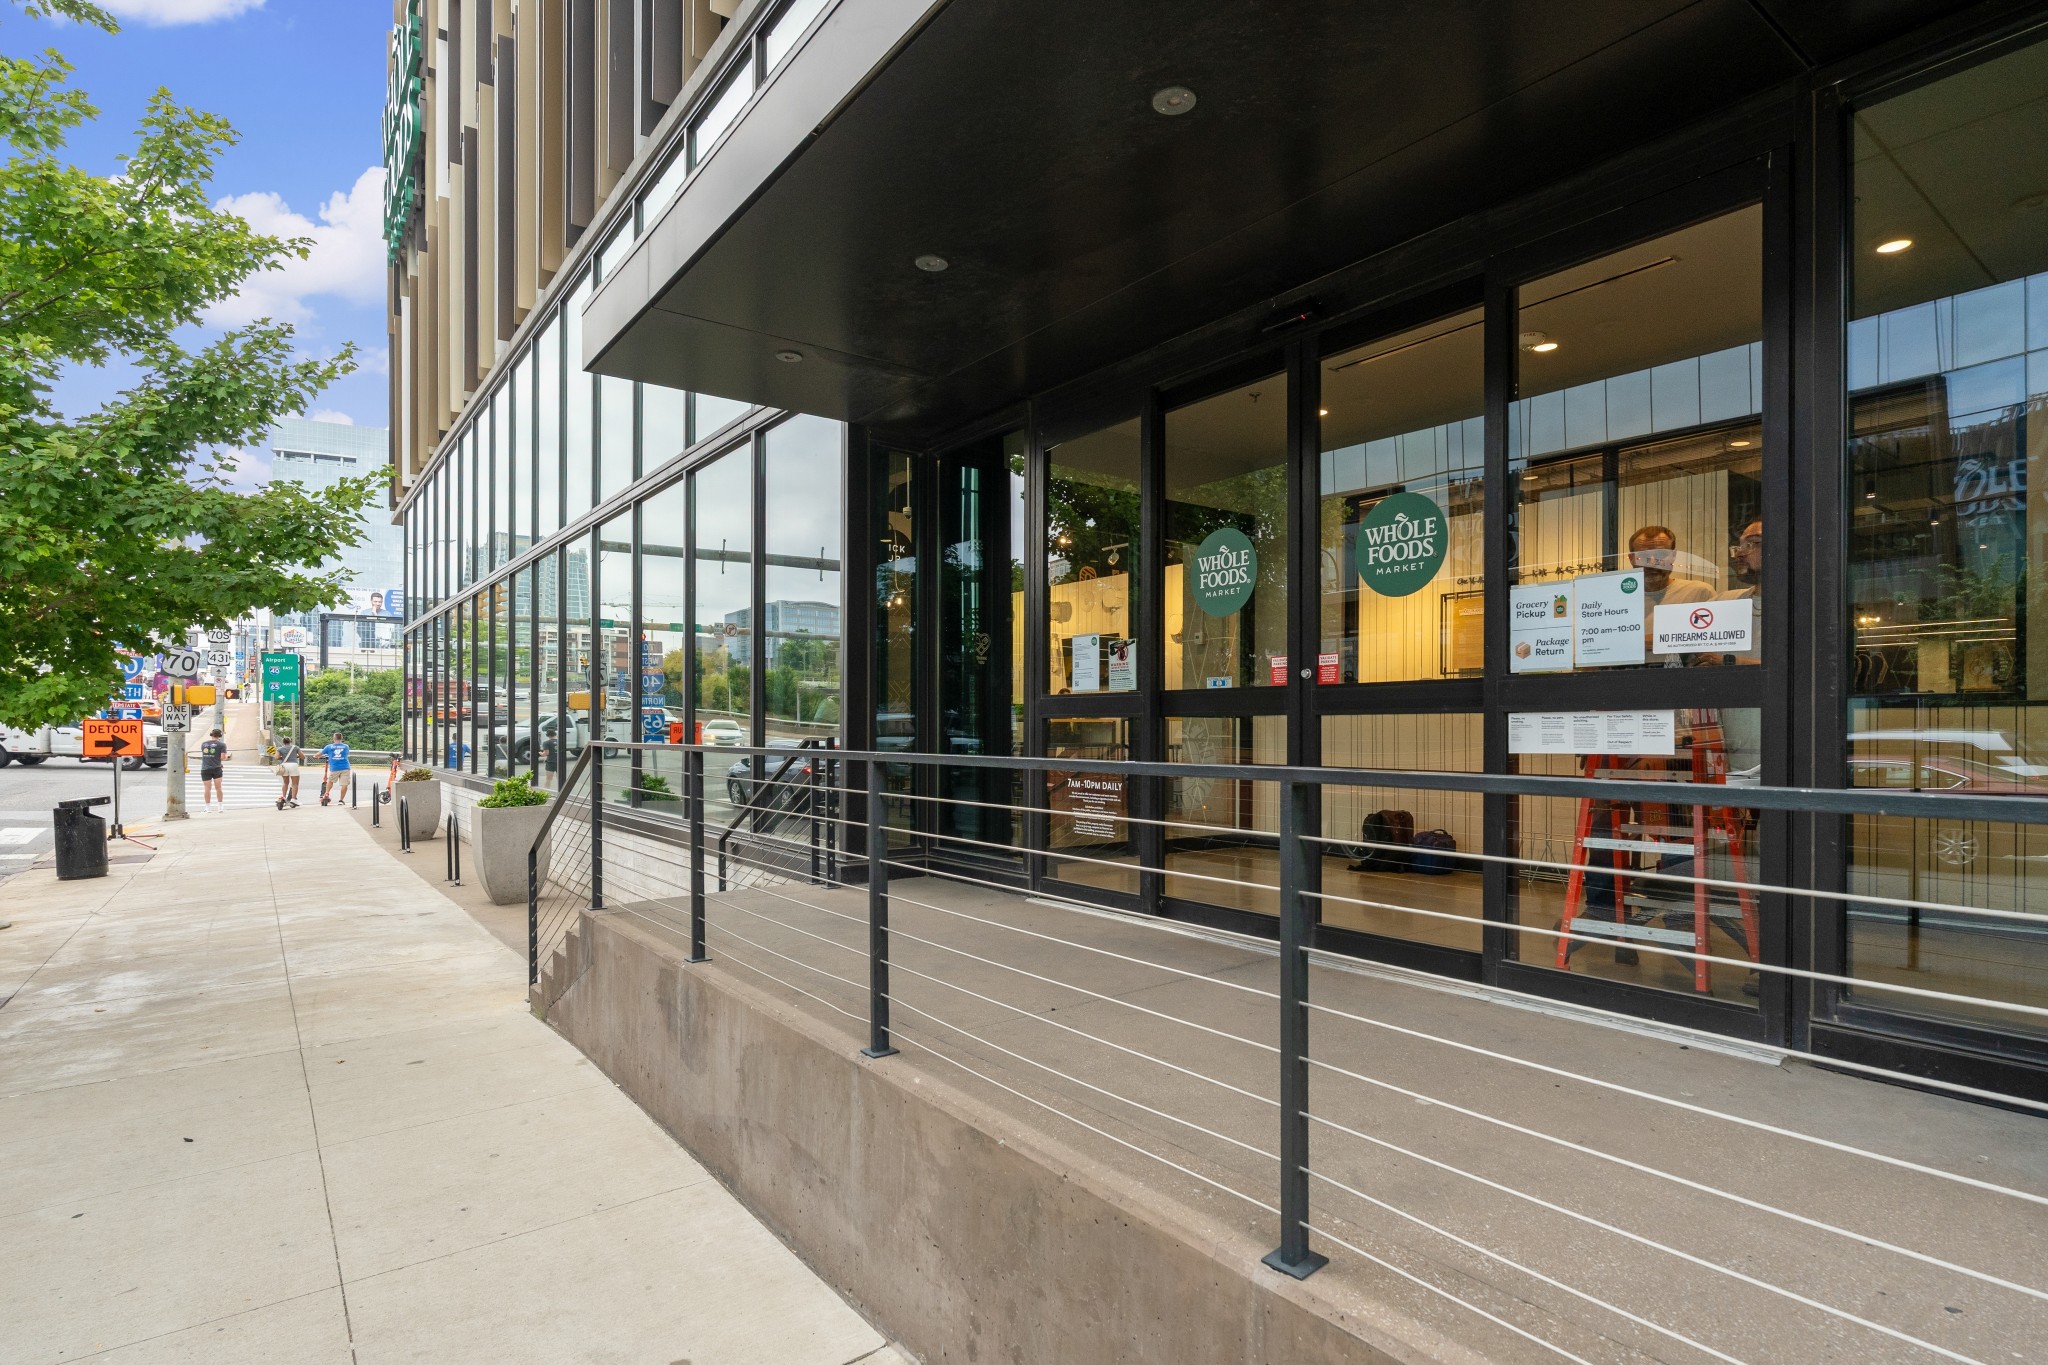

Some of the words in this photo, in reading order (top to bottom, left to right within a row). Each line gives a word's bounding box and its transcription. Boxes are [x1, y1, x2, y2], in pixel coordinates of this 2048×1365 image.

[1365, 515, 1437, 546] WHOLE
[888, 543, 906, 553] ICK
[1198, 548, 1250, 572] WHOLE
[1376, 562, 1424, 575] MARKET
[1555, 562, 1602, 575] ACTIO
[1206, 588, 1240, 598] MARKET
[1516, 600, 1548, 610] Grocery
[1581, 601, 1602, 610] Daily
[1516, 610, 1546, 619] Pickup
[1605, 608, 1628, 616] Hours
[210, 631, 230, 640] 70S
[1659, 634, 1670, 643] NO
[1671, 632, 1708, 642] FIREARMS
[1709, 630, 1745, 640] ALLOWED
[1536, 638, 1570, 647] Package
[1536, 648, 1564, 656] Return
[169, 654, 195, 672] 70
[210, 654, 228, 663] 431
[89, 725, 138, 734] DETOUR
[1102, 782, 1122, 791] DAILY
